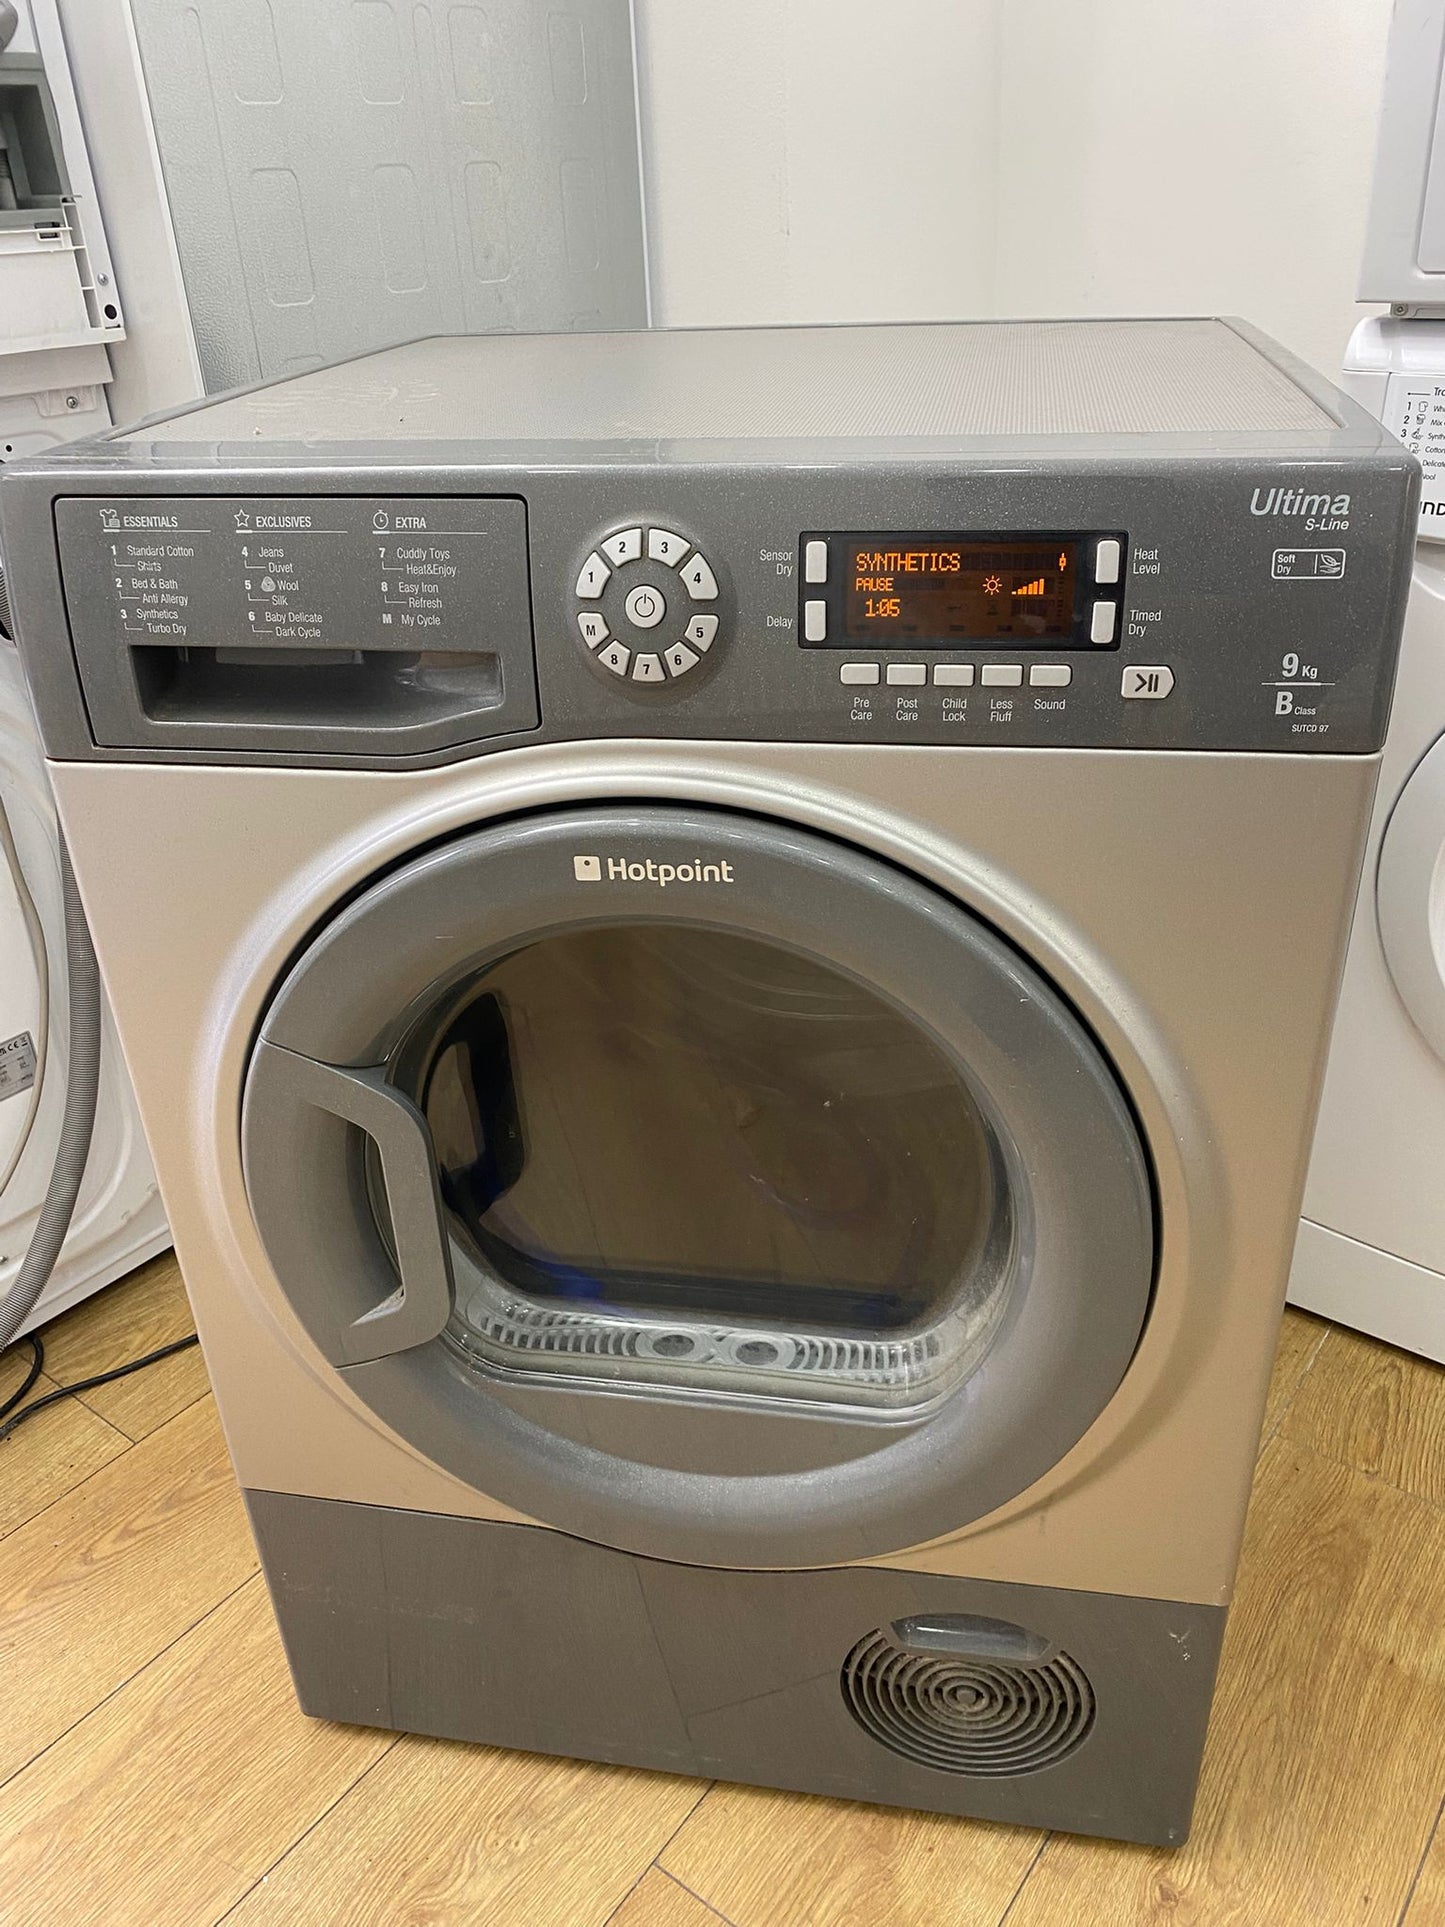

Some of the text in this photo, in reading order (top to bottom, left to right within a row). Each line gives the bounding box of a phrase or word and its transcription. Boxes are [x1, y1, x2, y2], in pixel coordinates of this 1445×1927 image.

[1403, 415, 1410, 424] 2
[1400, 428, 1407, 438] 3
[1250, 488, 1351, 516] Ultima
[123, 516, 178, 528] ESSENTIALS
[256, 516, 312, 528] EXCLUSIVES
[395, 517, 427, 529] EXTRA
[1305, 518, 1349, 531] S-Line
[111, 545, 194, 556] 1 Standard Cotton
[241, 546, 284, 558] 4 Jeans
[618, 541, 626, 553] 2
[661, 541, 669, 554] 3
[379, 548, 450, 560] 7 Cuddly Toys
[759, 549, 793, 561] Sensor
[1133, 548, 1158, 560] Heat
[1277, 554, 1296, 564] Soft
[137, 561, 162, 572] Shirts
[268, 562, 293, 573] Duvet
[856, 553, 960, 572] SYNTHETICS
[406, 564, 457, 577] Heat&Enjoy
[776, 564, 793, 577] Dry
[1132, 563, 1160, 575] Level
[1277, 565, 1291, 575] Dry
[588, 571, 594, 583] 1
[693, 572, 701, 584] 4
[115, 578, 178, 589] 2 Bed & Bath
[244, 580, 299, 591] 5 Wool
[381, 582, 439, 595] 8 Easy Iron
[856, 577, 894, 591] PAUSE
[142, 593, 189, 606] Anti Allergy
[271, 595, 288, 606] Silk
[408, 598, 443, 609] Refresh
[865, 599, 901, 617] 1:05
[120, 609, 179, 621] 3 Synthetics
[248, 612, 323, 624] 6 Baby Delicate
[382, 613, 441, 627] M My Cycle
[1129, 610, 1162, 621] Timed
[766, 615, 793, 629] Delay
[147, 623, 187, 635] Turbo Dry
[275, 626, 321, 639] Dark Cycle
[586, 625, 596, 636] M
[696, 627, 704, 638] 5
[1128, 624, 1147, 637] Dry
[611, 654, 618, 665] 8
[674, 655, 682, 665] 6
[1282, 652, 1318, 679] 9 Kg
[643, 663, 650, 674] 7
[853, 697, 869, 708] Pre
[897, 698, 918, 708] Post
[942, 698, 967, 709] Child
[990, 699, 1013, 709] Less
[1034, 699, 1066, 710] Sound
[1275, 691, 1316, 715] B Class
[850, 710, 872, 720] Care
[896, 710, 918, 721] Care
[942, 711, 966, 722] Lock
[990, 711, 1012, 722] Fluff
[1291, 724, 1329, 733] SUTCD 97
[607, 857, 734, 887] Hotpoint
